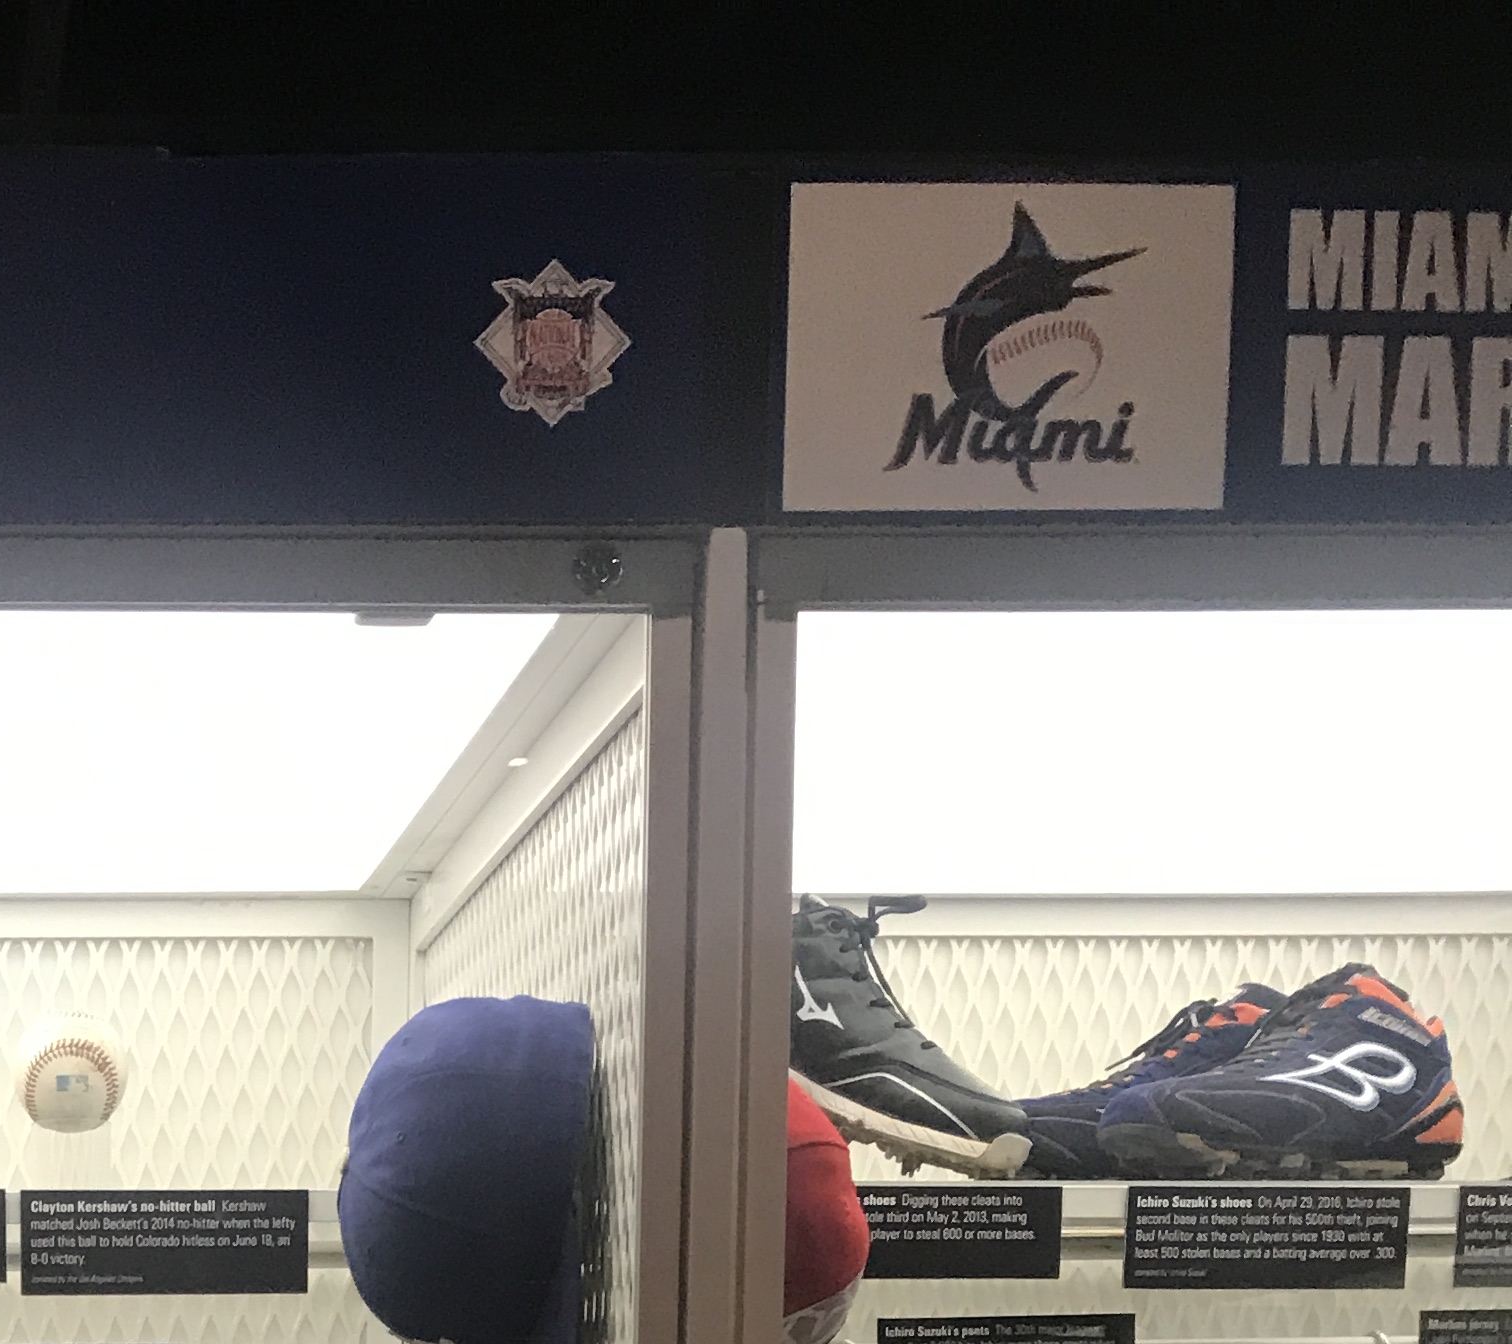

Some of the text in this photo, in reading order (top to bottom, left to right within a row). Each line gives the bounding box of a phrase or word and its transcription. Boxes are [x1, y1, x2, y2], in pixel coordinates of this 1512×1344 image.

[884, 390, 1138, 486] Miami
[864, 1194, 896, 1205] shoes
[1137, 1196, 1252, 1208] Ichiro Suzuki's shoes
[31, 1200, 215, 1215] Clayton Kershaw's no-hitter ball
[904, 1230, 913, 1239] to
[916, 1229, 940, 1240] steal
[965, 1231, 974, 1239] or
[977, 1230, 1002, 1239] more
[1005, 1229, 1035, 1239] bases.
